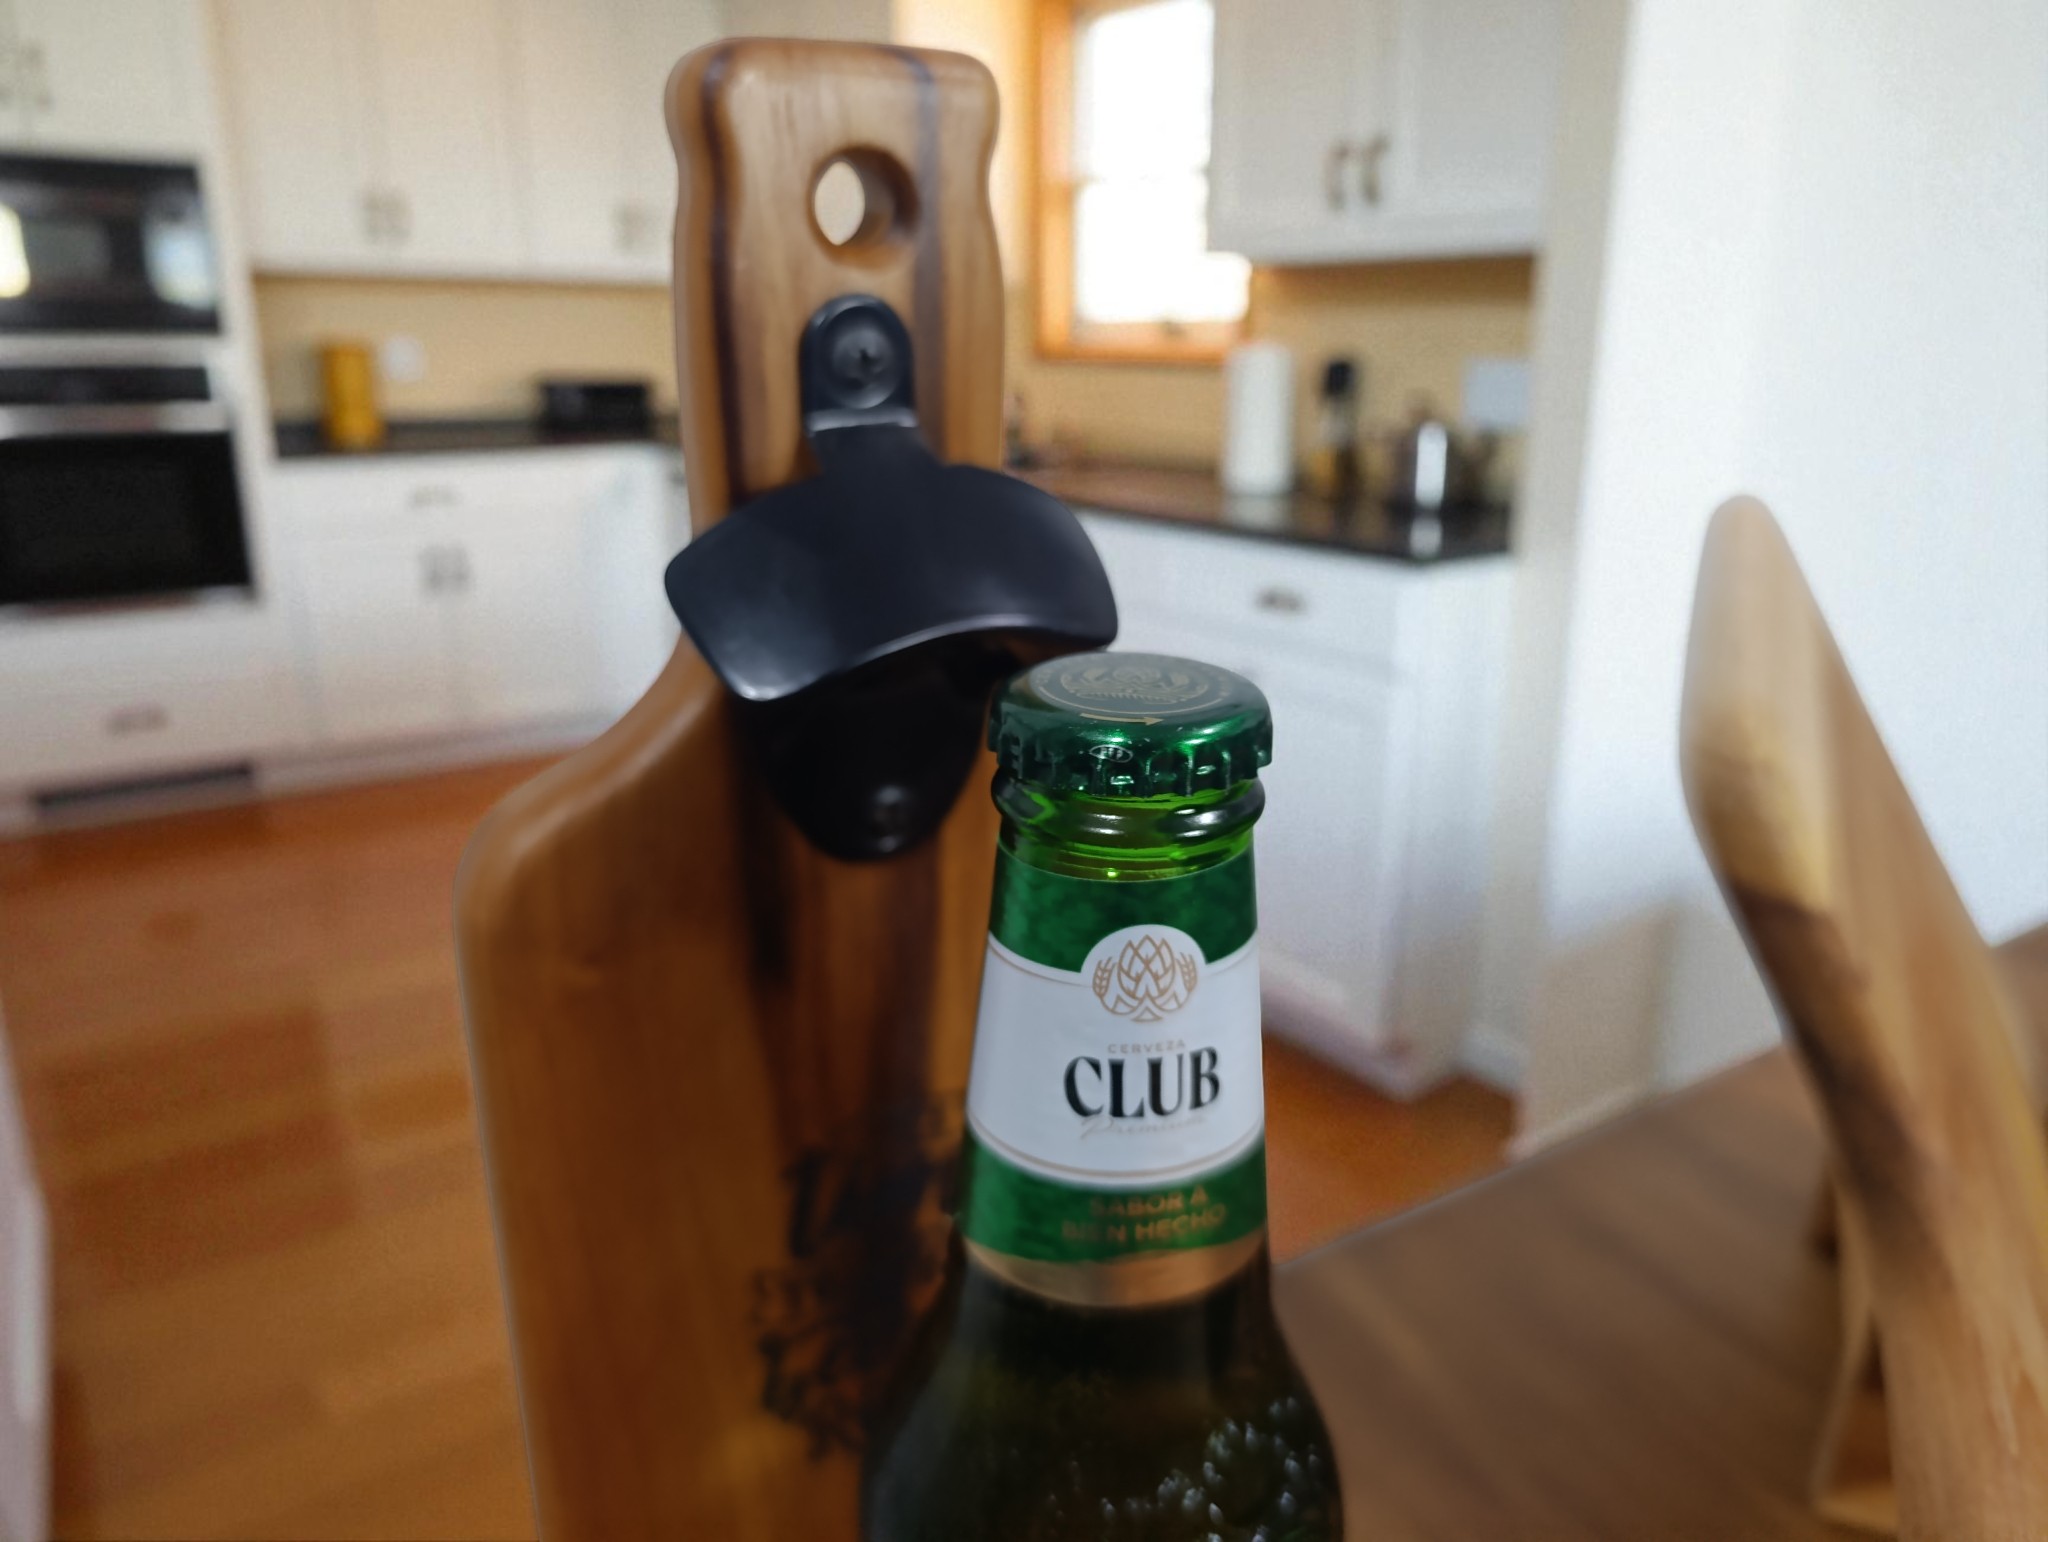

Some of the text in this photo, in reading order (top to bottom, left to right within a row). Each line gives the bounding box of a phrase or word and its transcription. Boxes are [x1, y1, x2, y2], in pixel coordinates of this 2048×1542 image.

[1107, 1039, 1187, 1054] CERVEZA
[1063, 1046, 1221, 1118] CLUB
[1089, 1184, 1208, 1217] SABOR A
[1134, 1203, 1227, 1242] HECHO
